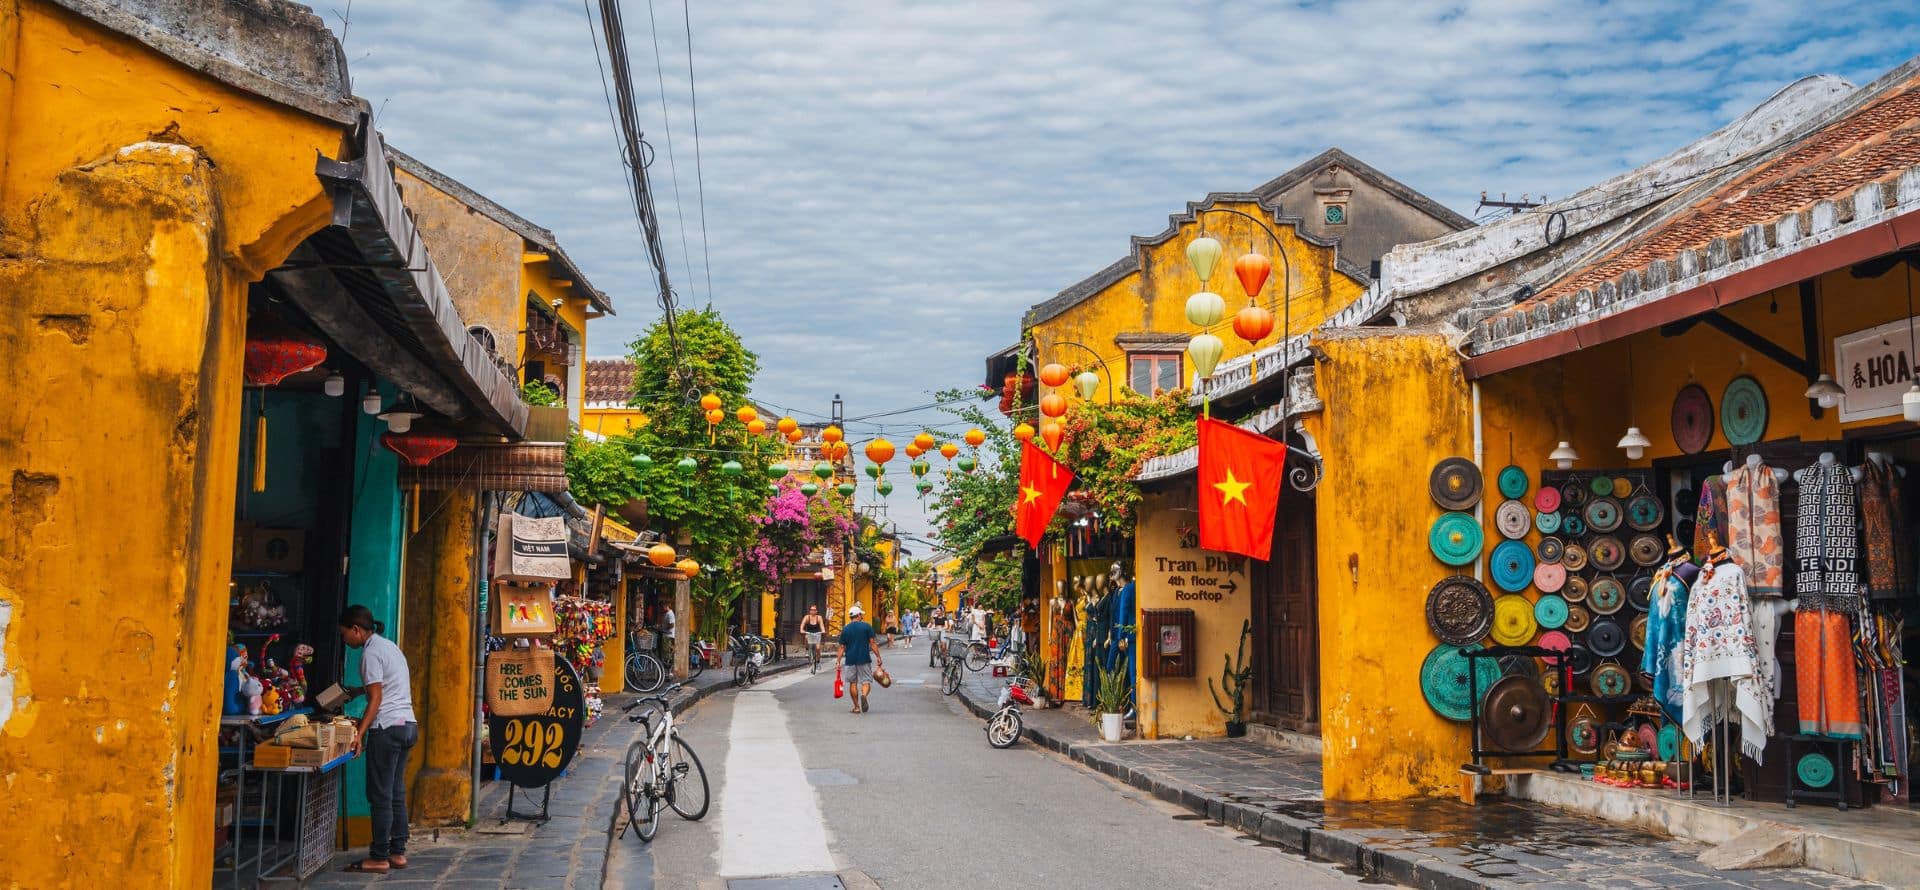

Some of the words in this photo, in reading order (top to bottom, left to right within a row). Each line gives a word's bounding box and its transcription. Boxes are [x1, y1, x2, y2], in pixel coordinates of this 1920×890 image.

[535, 545, 551, 553] NAM
[1155, 556, 1198, 572] Tran
[1801, 558, 1854, 571] FENDI
[1168, 575, 1185, 586] 4th
[1191, 575, 1218, 586] floor
[1176, 590, 1222, 602] Rooftop
[500, 663, 523, 675] HERE
[504, 674, 542, 688] COMES
[555, 666, 573, 692] UỐC
[499, 689, 518, 700] THE
[523, 687, 547, 700] SUN
[539, 706, 575, 718] ACY
[501, 718, 564, 768] 292
